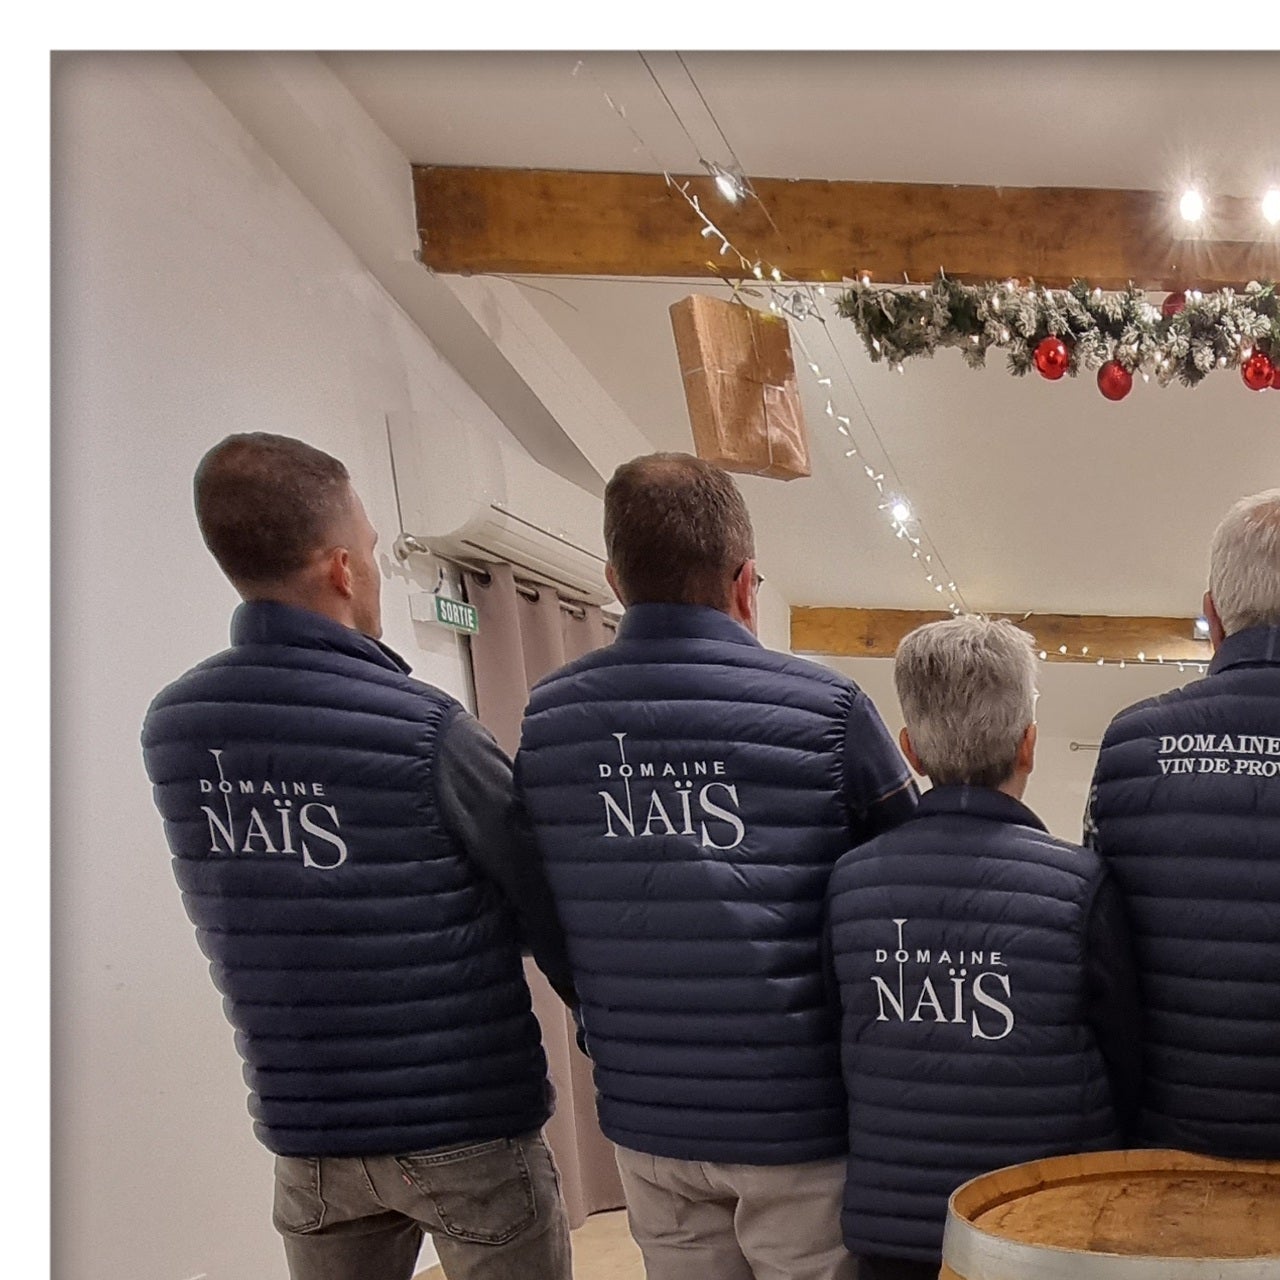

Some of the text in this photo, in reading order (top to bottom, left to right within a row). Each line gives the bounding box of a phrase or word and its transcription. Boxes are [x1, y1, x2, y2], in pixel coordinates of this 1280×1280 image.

[440, 599, 475, 628] SORTIE
[599, 761, 726, 777] DOMAINE
[1158, 758, 1196, 774] VIN
[1198, 758, 1231, 774] DE
[200, 779, 326, 796] DOMAINE
[598, 780, 746, 850] NAÏS
[200, 799, 348, 870] NAÏS
[875, 949, 1008, 966] DOMAINE
[870, 968, 1015, 1040] NAÏS
